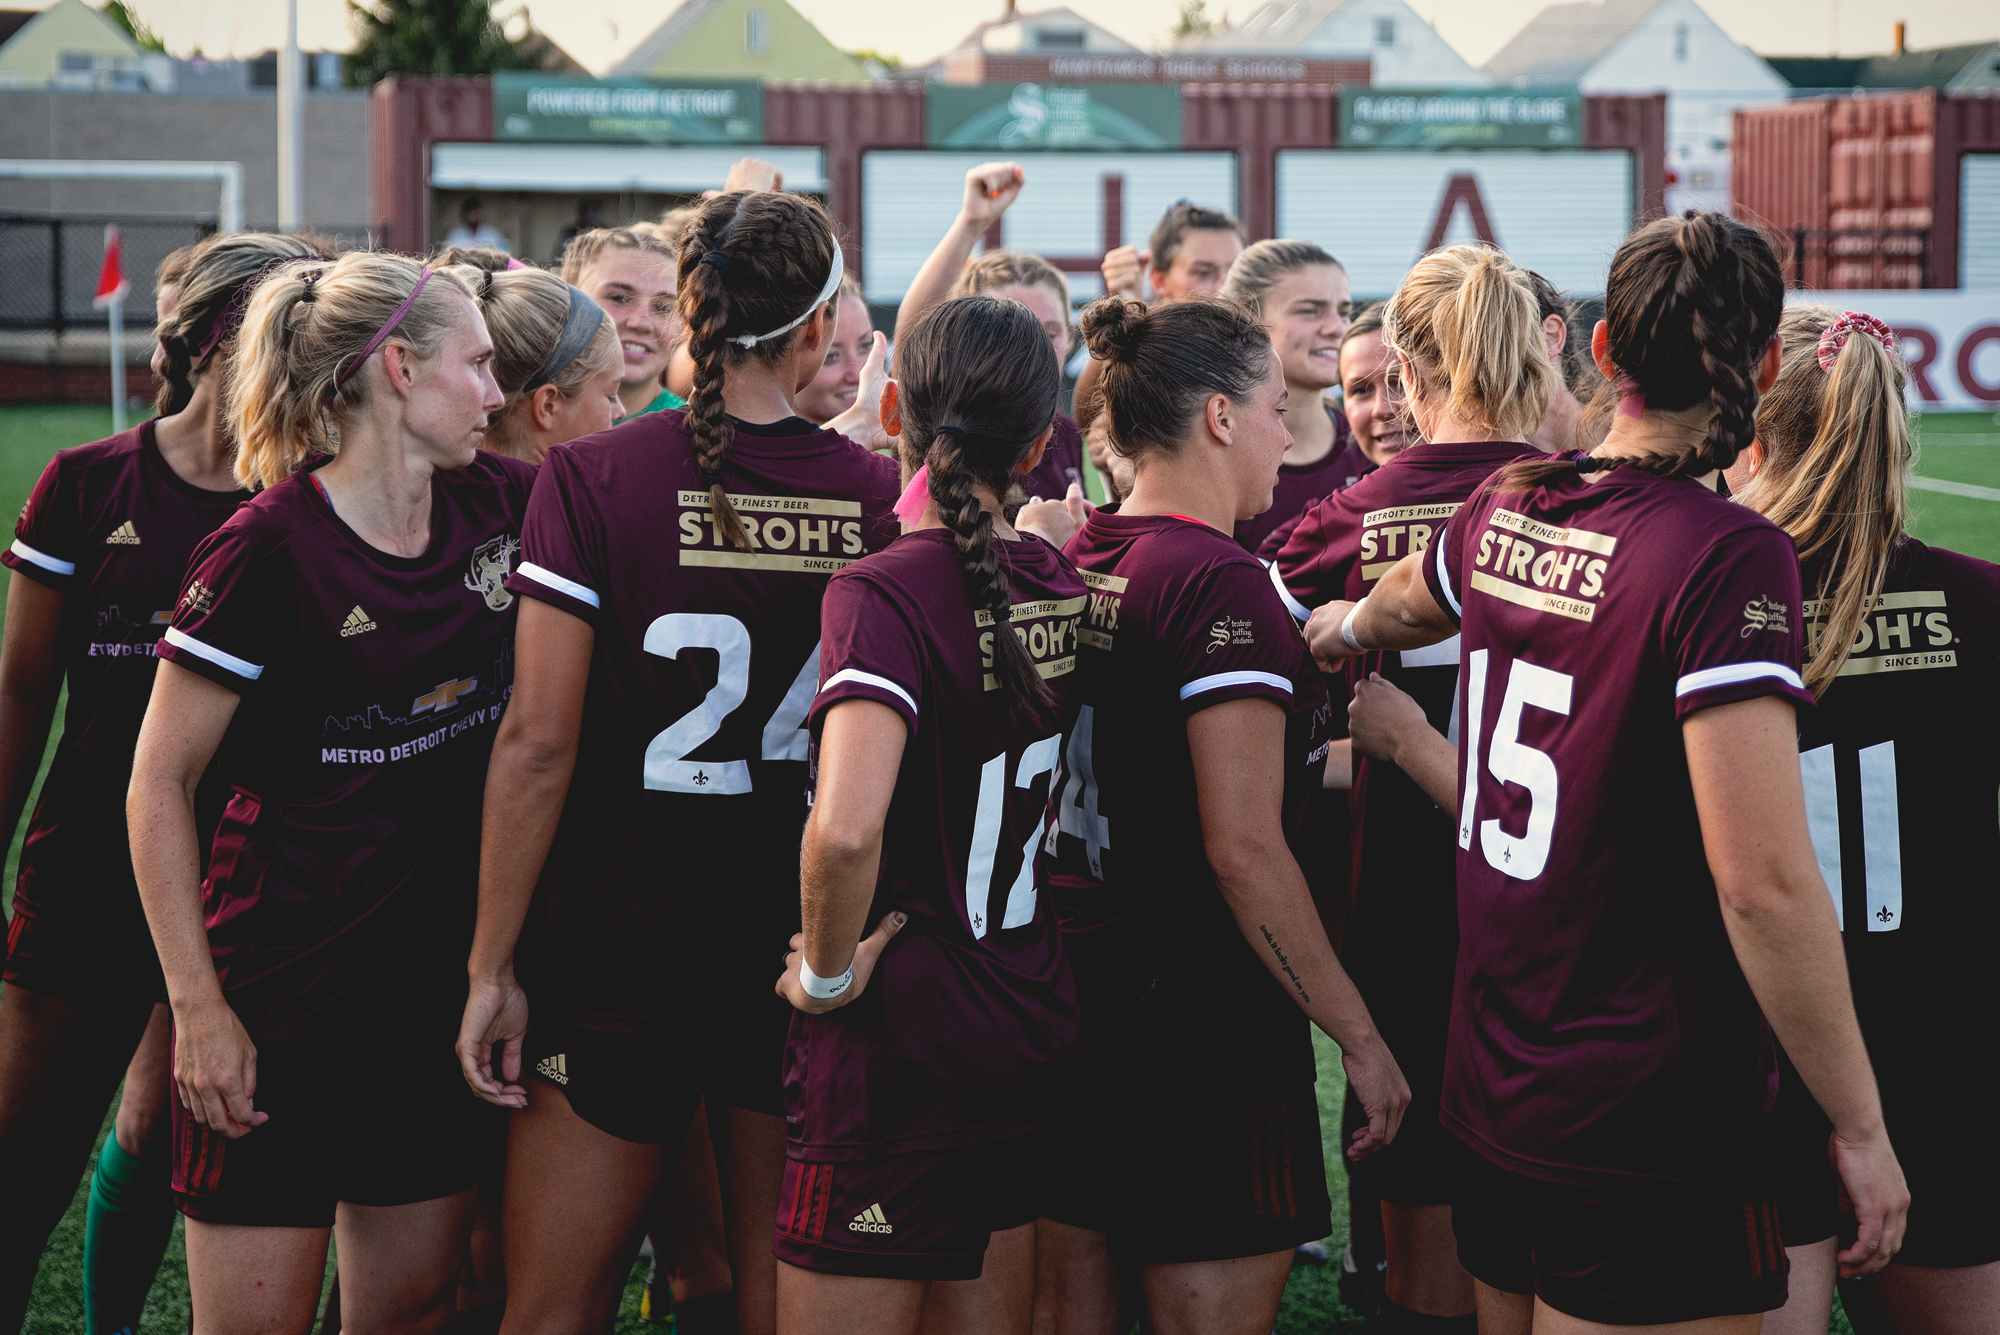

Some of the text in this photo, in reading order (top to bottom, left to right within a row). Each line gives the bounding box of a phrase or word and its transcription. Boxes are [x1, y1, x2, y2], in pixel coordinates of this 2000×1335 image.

[527, 88, 611, 116] POWERED
[742, 498, 780, 510] FINEST
[783, 502, 809, 510] BEER
[1367, 509, 1414, 523] DETROIT'S
[1417, 506, 1454, 516] FINEST
[106, 534, 141, 545] adidas
[1529, 524, 1561, 540] FINEST
[803, 560, 834, 569] SINCE
[1016, 606, 1037, 616] FINEST
[1039, 603, 1057, 612] BEER
[1544, 597, 1590, 616] SINCE 1850
[340, 621, 377, 637] adidas
[1053, 661, 1066, 673] SINCE
[1885, 655, 1951, 667] SINCE 1850
[321, 748, 385, 764] METRO
[390, 727, 447, 761] DETROIT
[450, 708, 486, 738] CHEVY
[1459, 648, 1574, 881] 15
[1274, 947, 1287, 966] looks
[1282, 966, 1299, 982] good
[1295, 982, 1302, 990] on
[1298, 990, 1310, 1002] you
[537, 1062, 568, 1085] adidas
[849, 1221, 892, 1234] adidas
